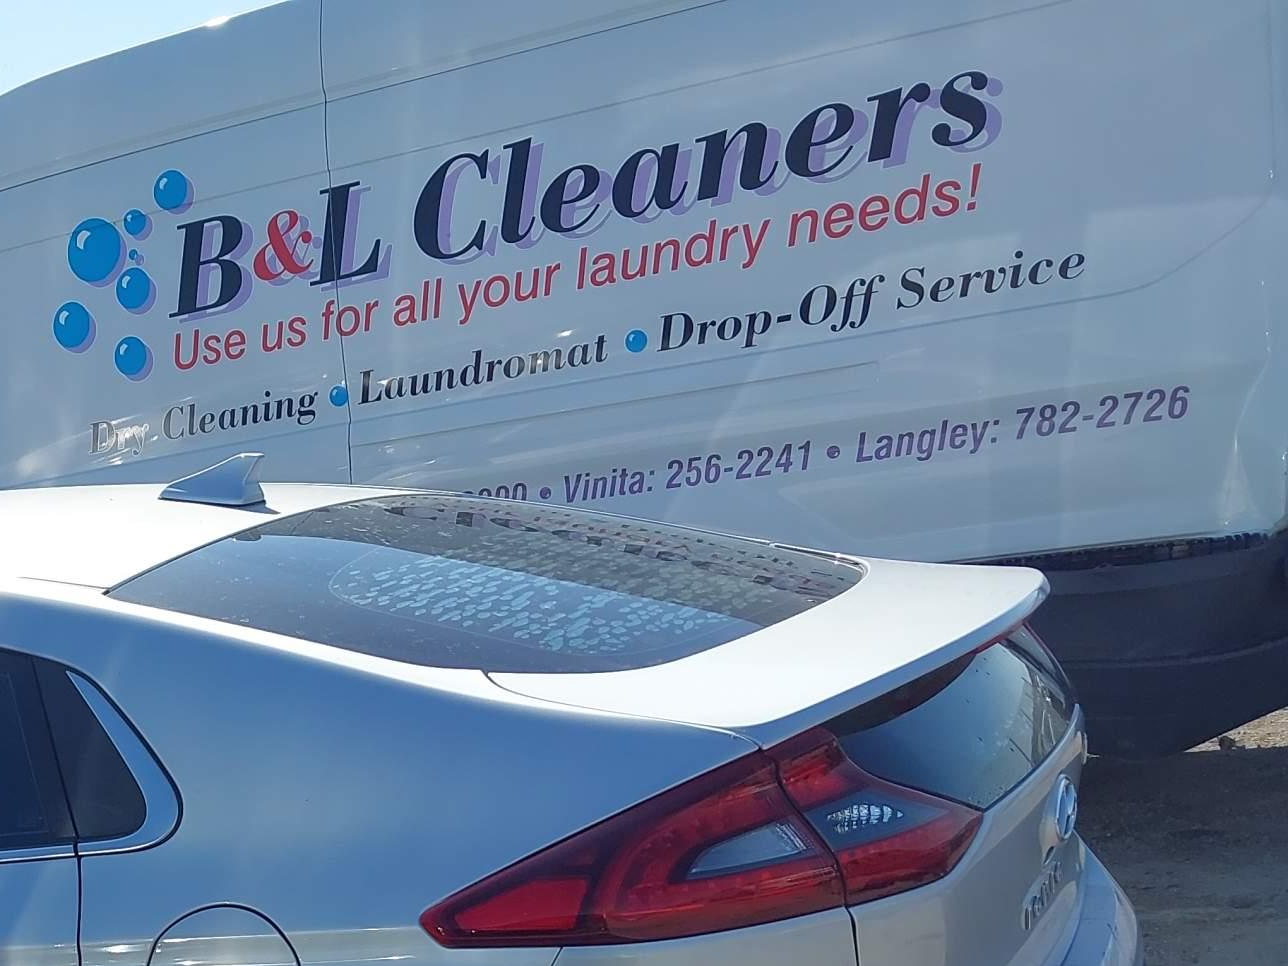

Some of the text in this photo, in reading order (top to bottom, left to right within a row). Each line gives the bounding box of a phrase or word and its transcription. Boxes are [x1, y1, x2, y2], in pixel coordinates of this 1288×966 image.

[168, 69, 992, 320] B&L Cleaners
[173, 163, 983, 370] Use us for all your laundry needs!
[88, 248, 1086, 456] Dry Cleaning Laundromat Drop-Off Service
[563, 385, 1192, 503] Vinita: 256-2241 Langley: 782-2726
